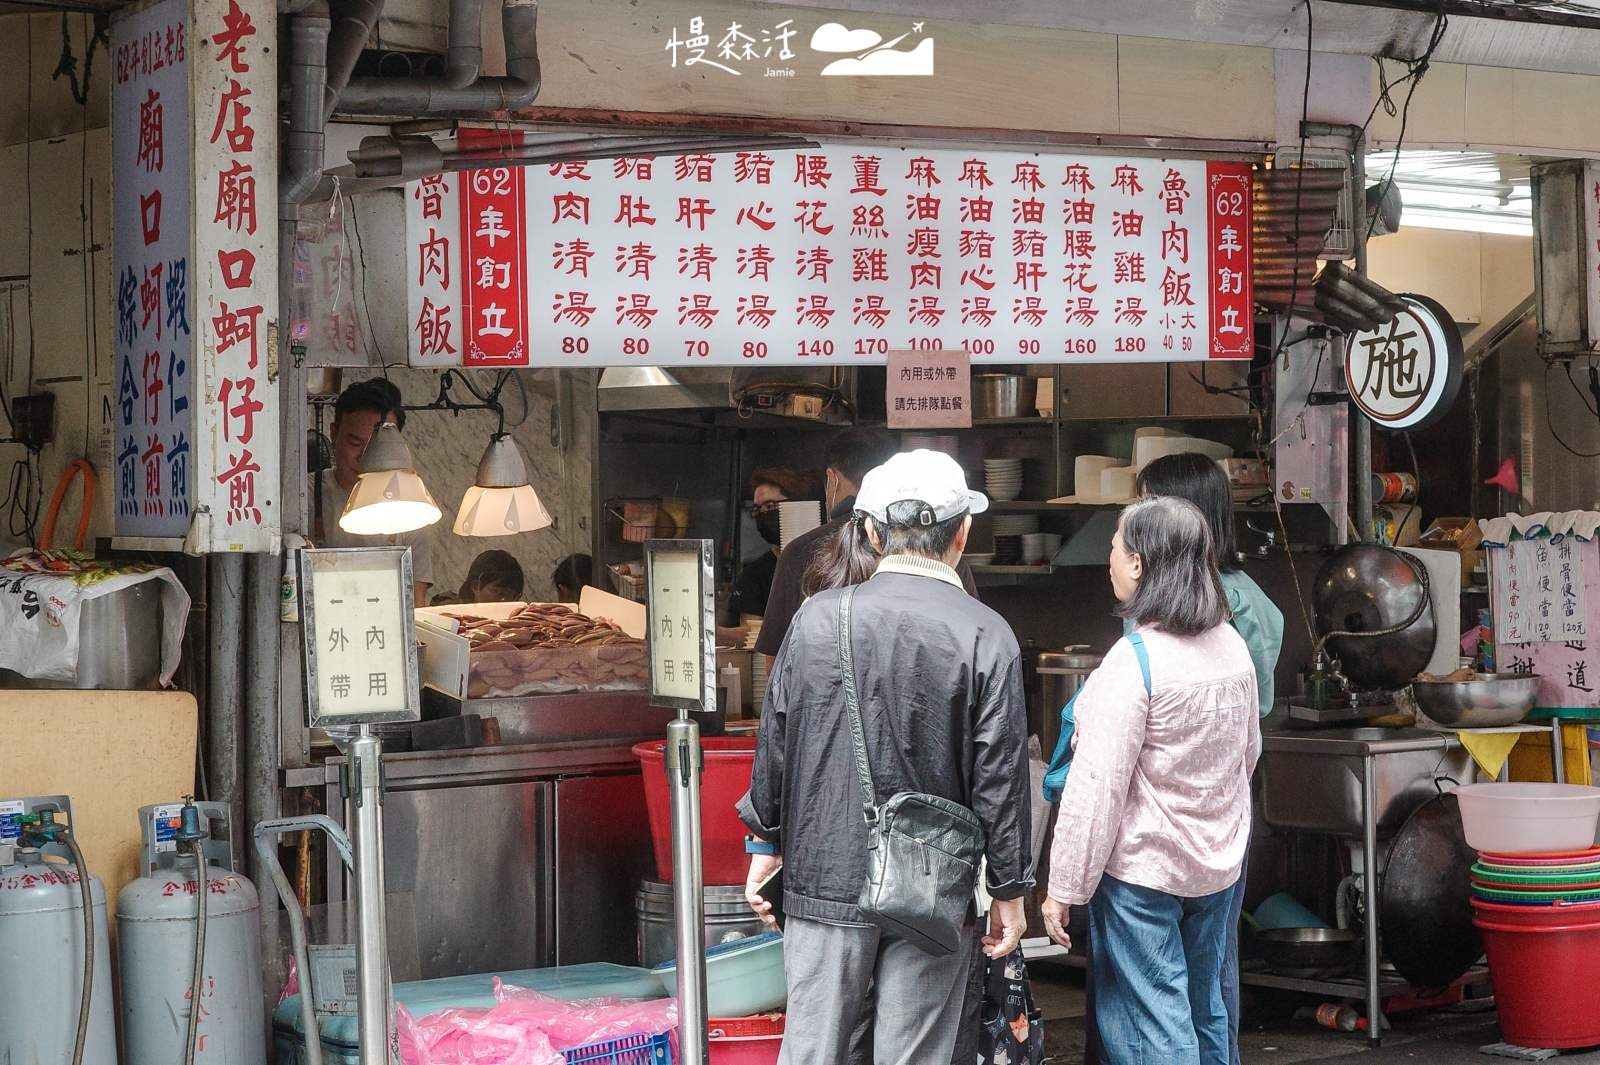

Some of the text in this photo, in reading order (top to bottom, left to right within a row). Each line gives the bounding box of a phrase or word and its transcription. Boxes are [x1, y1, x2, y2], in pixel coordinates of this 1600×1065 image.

[117, 21, 185, 85] 62年創立老店
[210, 0, 264, 526] 老店廟口蚵仔煎
[415, 174, 457, 356] 魯肉飯
[473, 168, 514, 338] 62年創立
[614, 155, 659, 355] 豬肚清湯 80
[675, 153, 720, 357] 豬肝清湯 70
[735, 152, 777, 358] 豬心清湯 80
[794, 154, 836, 357] 腰花清湯 140
[850, 155, 891, 355] 薑絲雞湯 170
[905, 156, 945, 351] 麻油瘦肉湯 100
[958, 158, 997, 355] 麻油豬心湯 100
[1011, 161, 1048, 355] 麻油豬肝湯 90
[1062, 163, 1099, 354] 麻油腰花湯 160
[1111, 165, 1148, 352] 麻油雞湯 180
[1158, 168, 1195, 307] 魯肉飯
[1216, 191, 1244, 335] 62年創立
[118, 265, 139, 517] 綜合煎
[166, 257, 190, 517] 蝦仁煎
[562, 337, 590, 354] 80
[894, 396, 963, 411] 請先排隊點餐
[900, 366, 957, 381] 內用或外帶
[1159, 312, 1177, 350] 小 40
[1181, 311, 1197, 351] 大 50
[1359, 316, 1423, 401] 施
[328, 627, 351, 700] 外帶
[365, 625, 388, 697] 內用
[661, 614, 675, 682] 內用
[680, 615, 694, 683] 外帶
